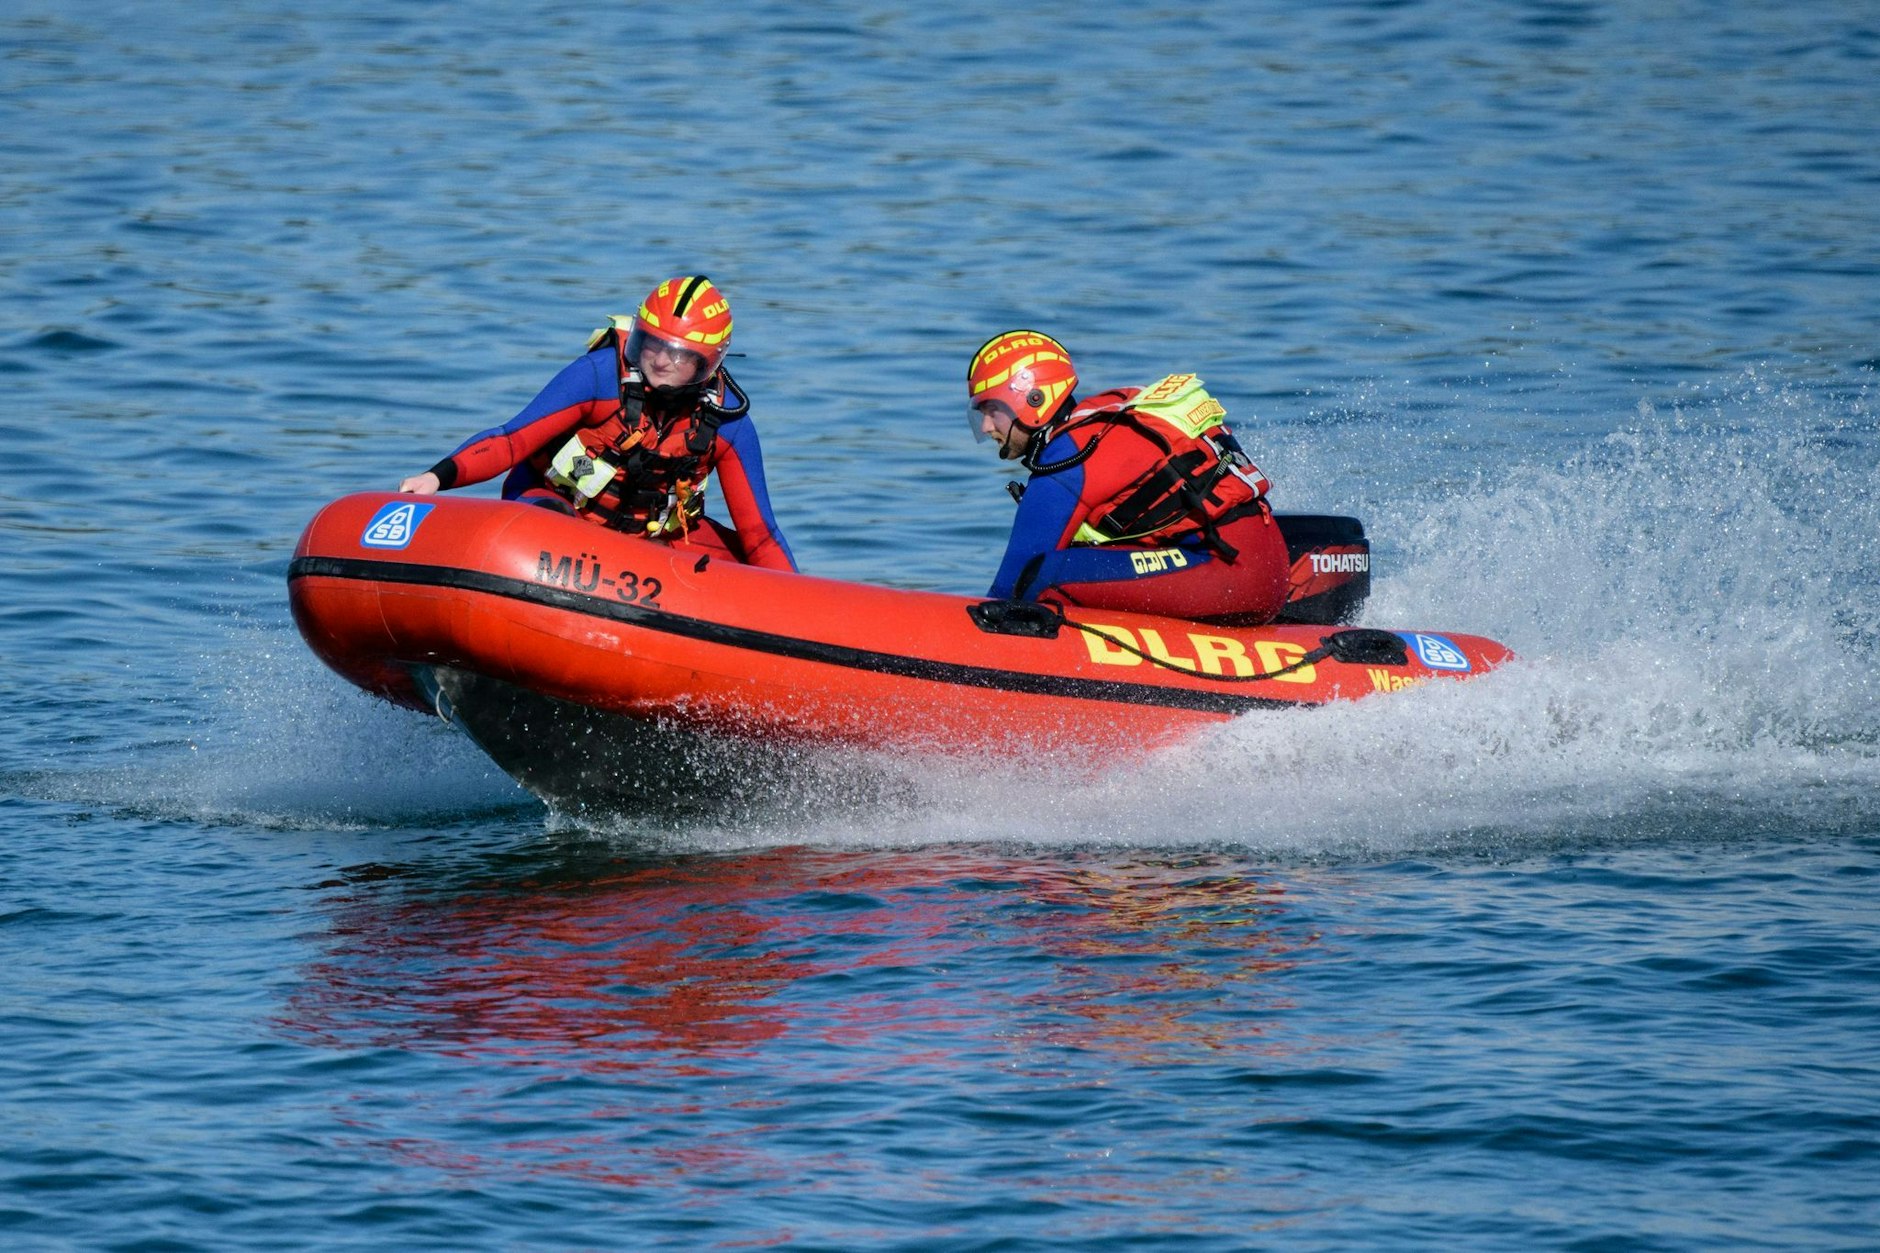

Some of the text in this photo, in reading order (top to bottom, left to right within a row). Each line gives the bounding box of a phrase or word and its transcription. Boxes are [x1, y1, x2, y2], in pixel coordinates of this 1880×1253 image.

[984, 338, 1043, 365] DLRG
[536, 550, 662, 609] MÜ-32
[1310, 553, 1369, 573] TOHATSU
[1080, 623, 1317, 684] DLRG
